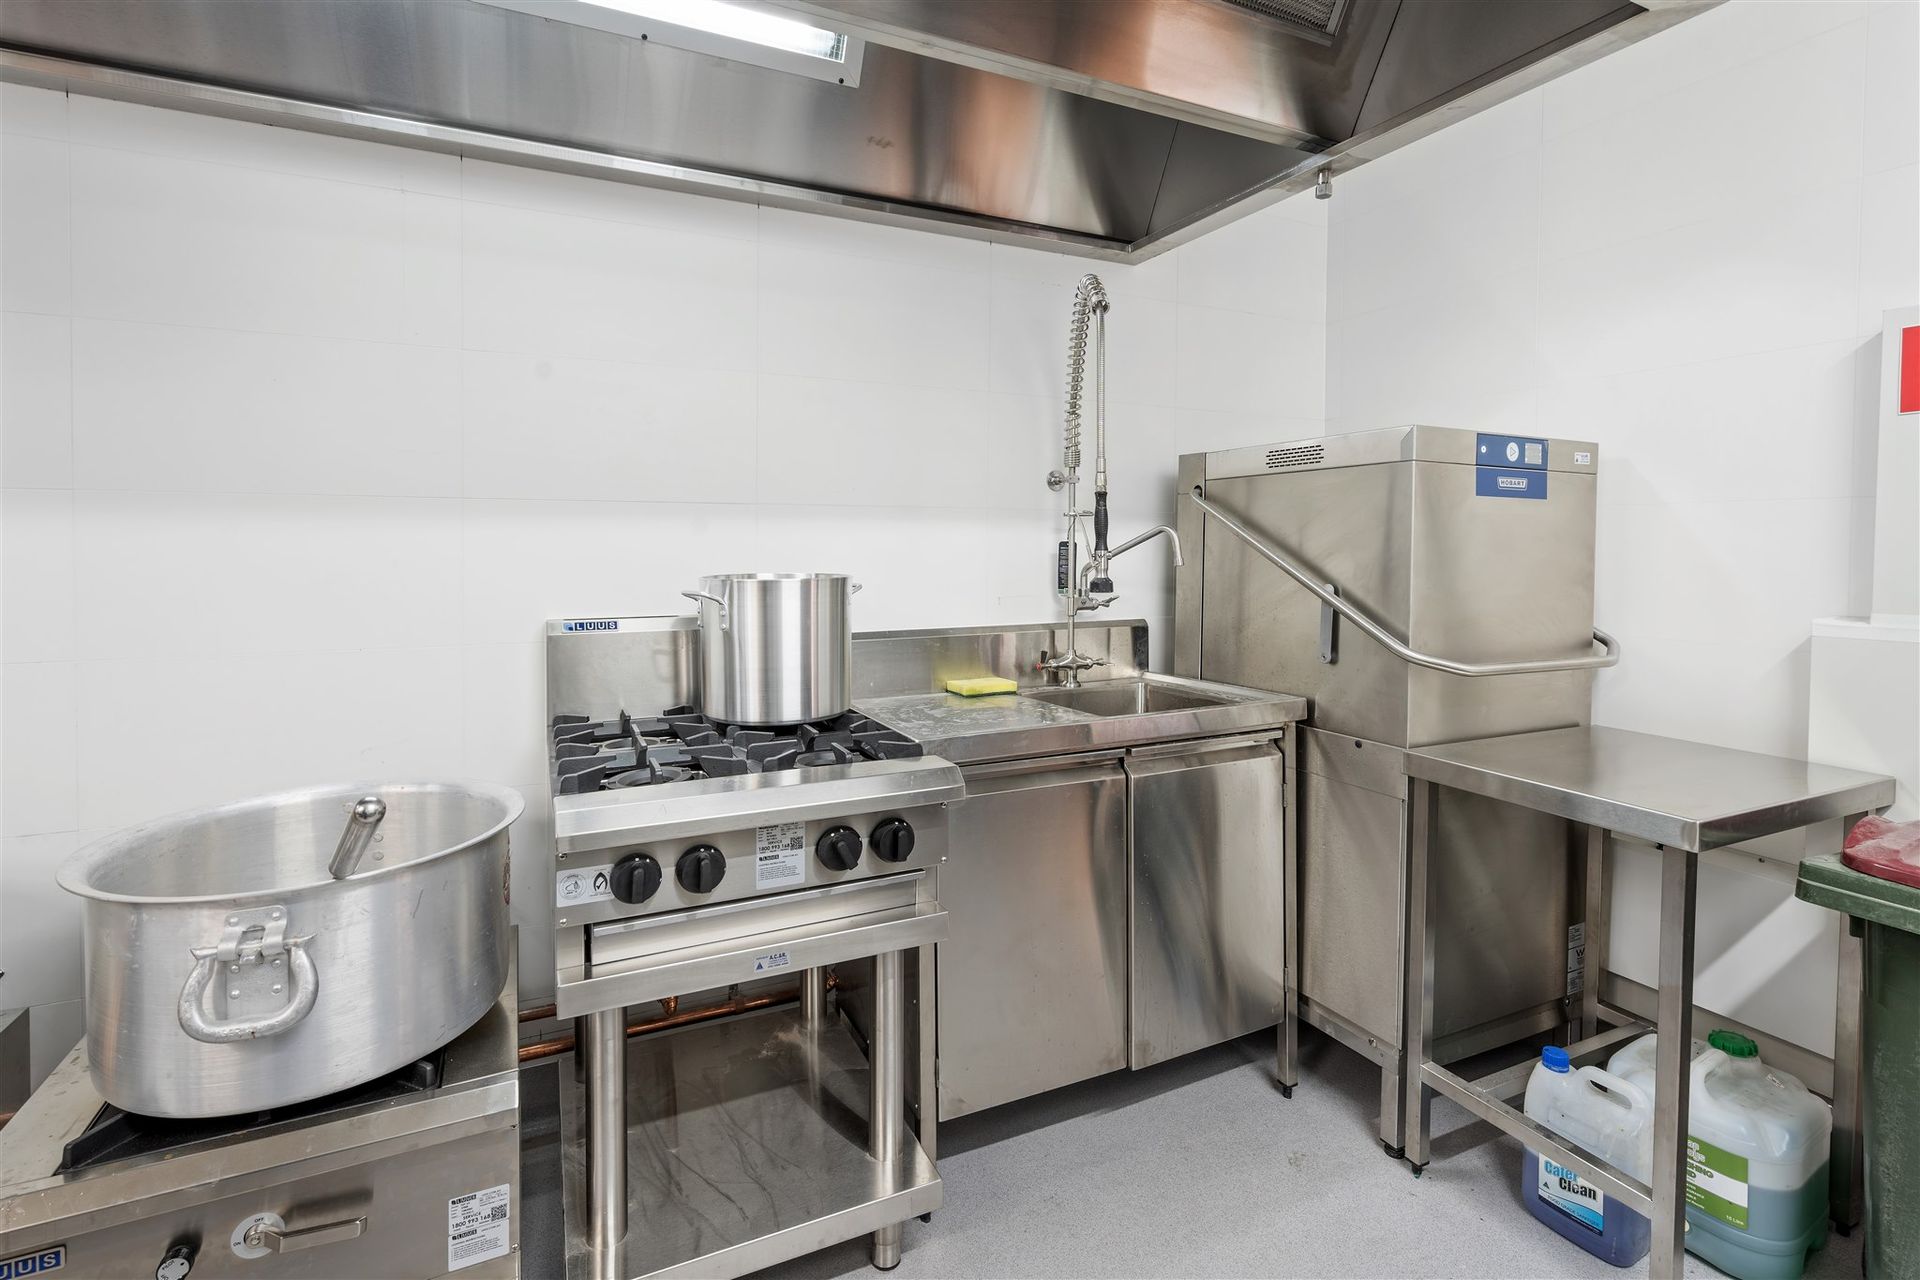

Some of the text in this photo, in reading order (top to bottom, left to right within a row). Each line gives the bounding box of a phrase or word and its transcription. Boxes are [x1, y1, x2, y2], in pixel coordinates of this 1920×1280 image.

[1500, 479, 1525, 487] HOBART
[575, 621, 617, 630] LUUS
[1544, 1161, 1578, 1182] Cater
[1559, 1177, 1597, 1200] Clean
[463, 1212, 481, 1220] SERVICE
[452, 1221, 466, 1229] 1800
